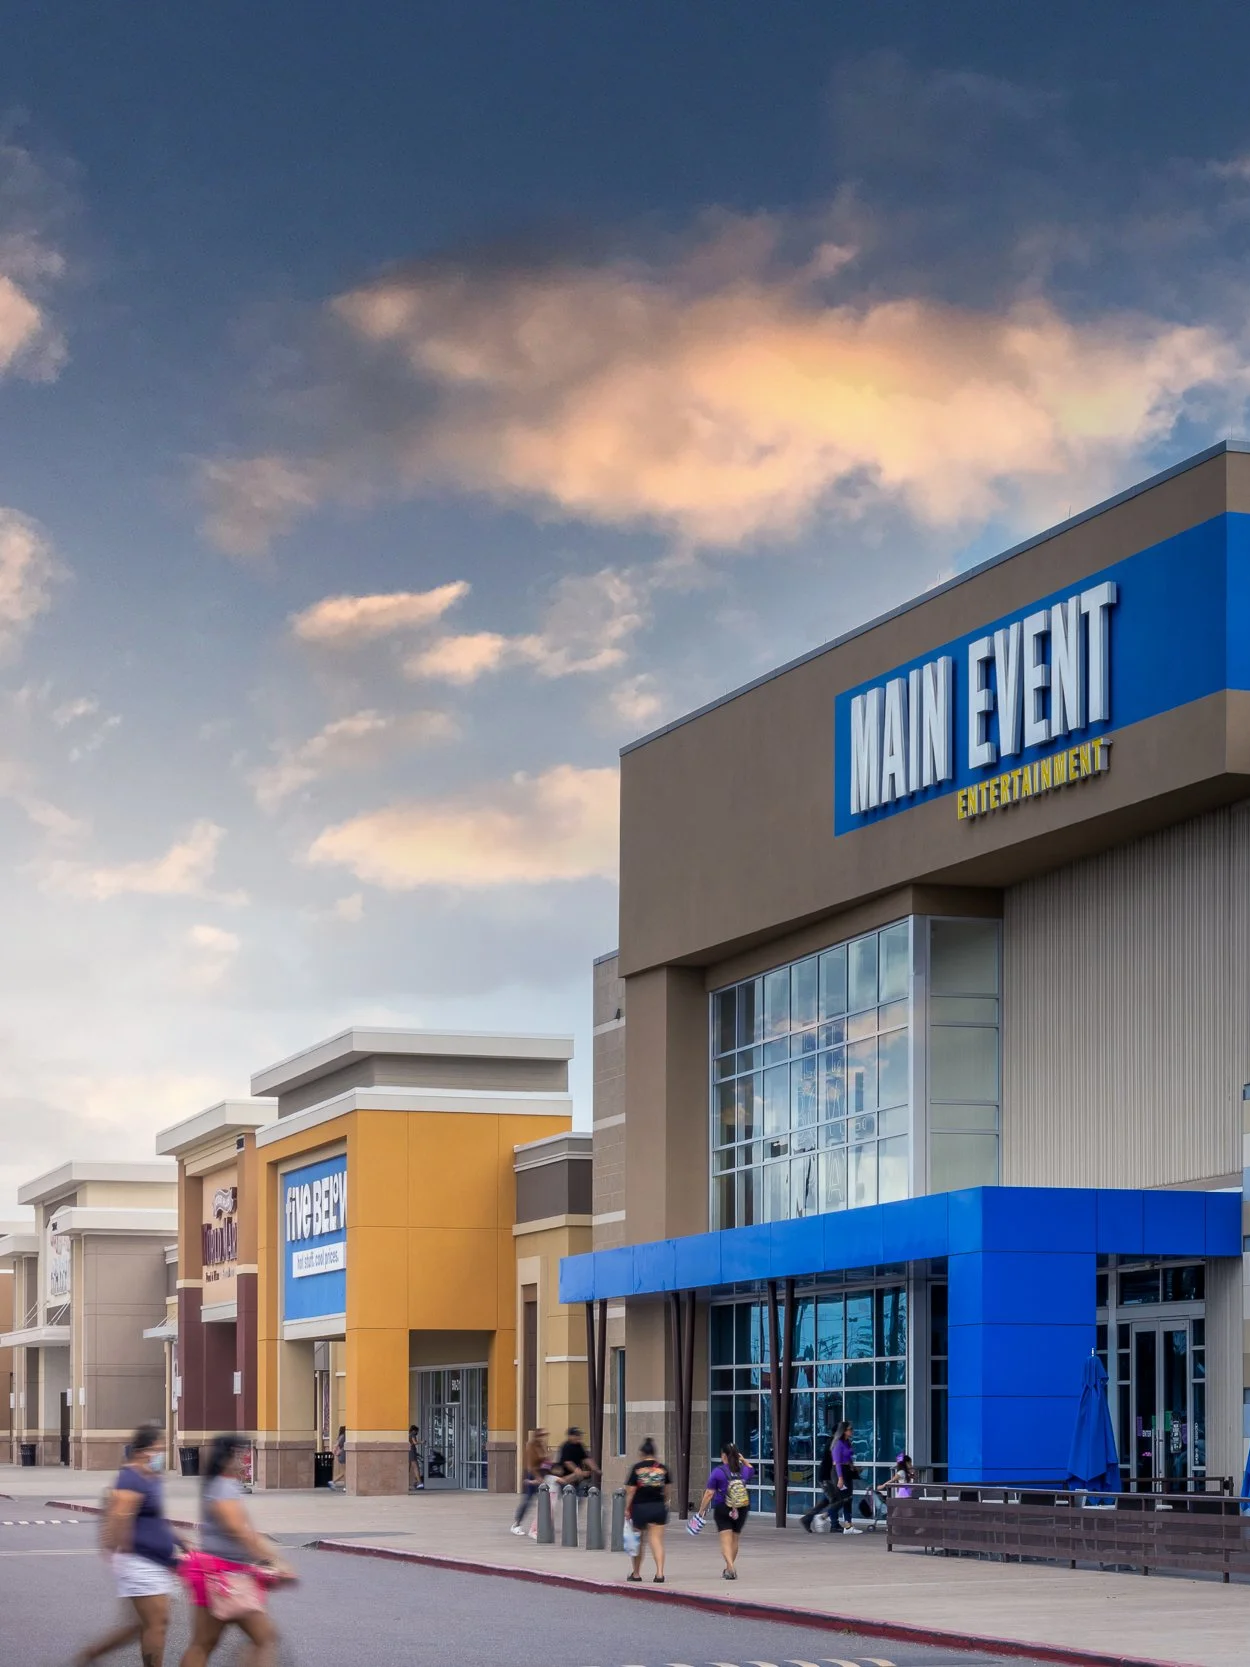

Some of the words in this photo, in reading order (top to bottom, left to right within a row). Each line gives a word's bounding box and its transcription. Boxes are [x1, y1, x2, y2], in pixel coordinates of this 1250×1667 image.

[851, 656, 952, 815] MAIN
[968, 581, 1116, 769] EVENT
[957, 737, 1112, 820] ENTERTAINMENT
[286, 1184, 311, 1241] five
